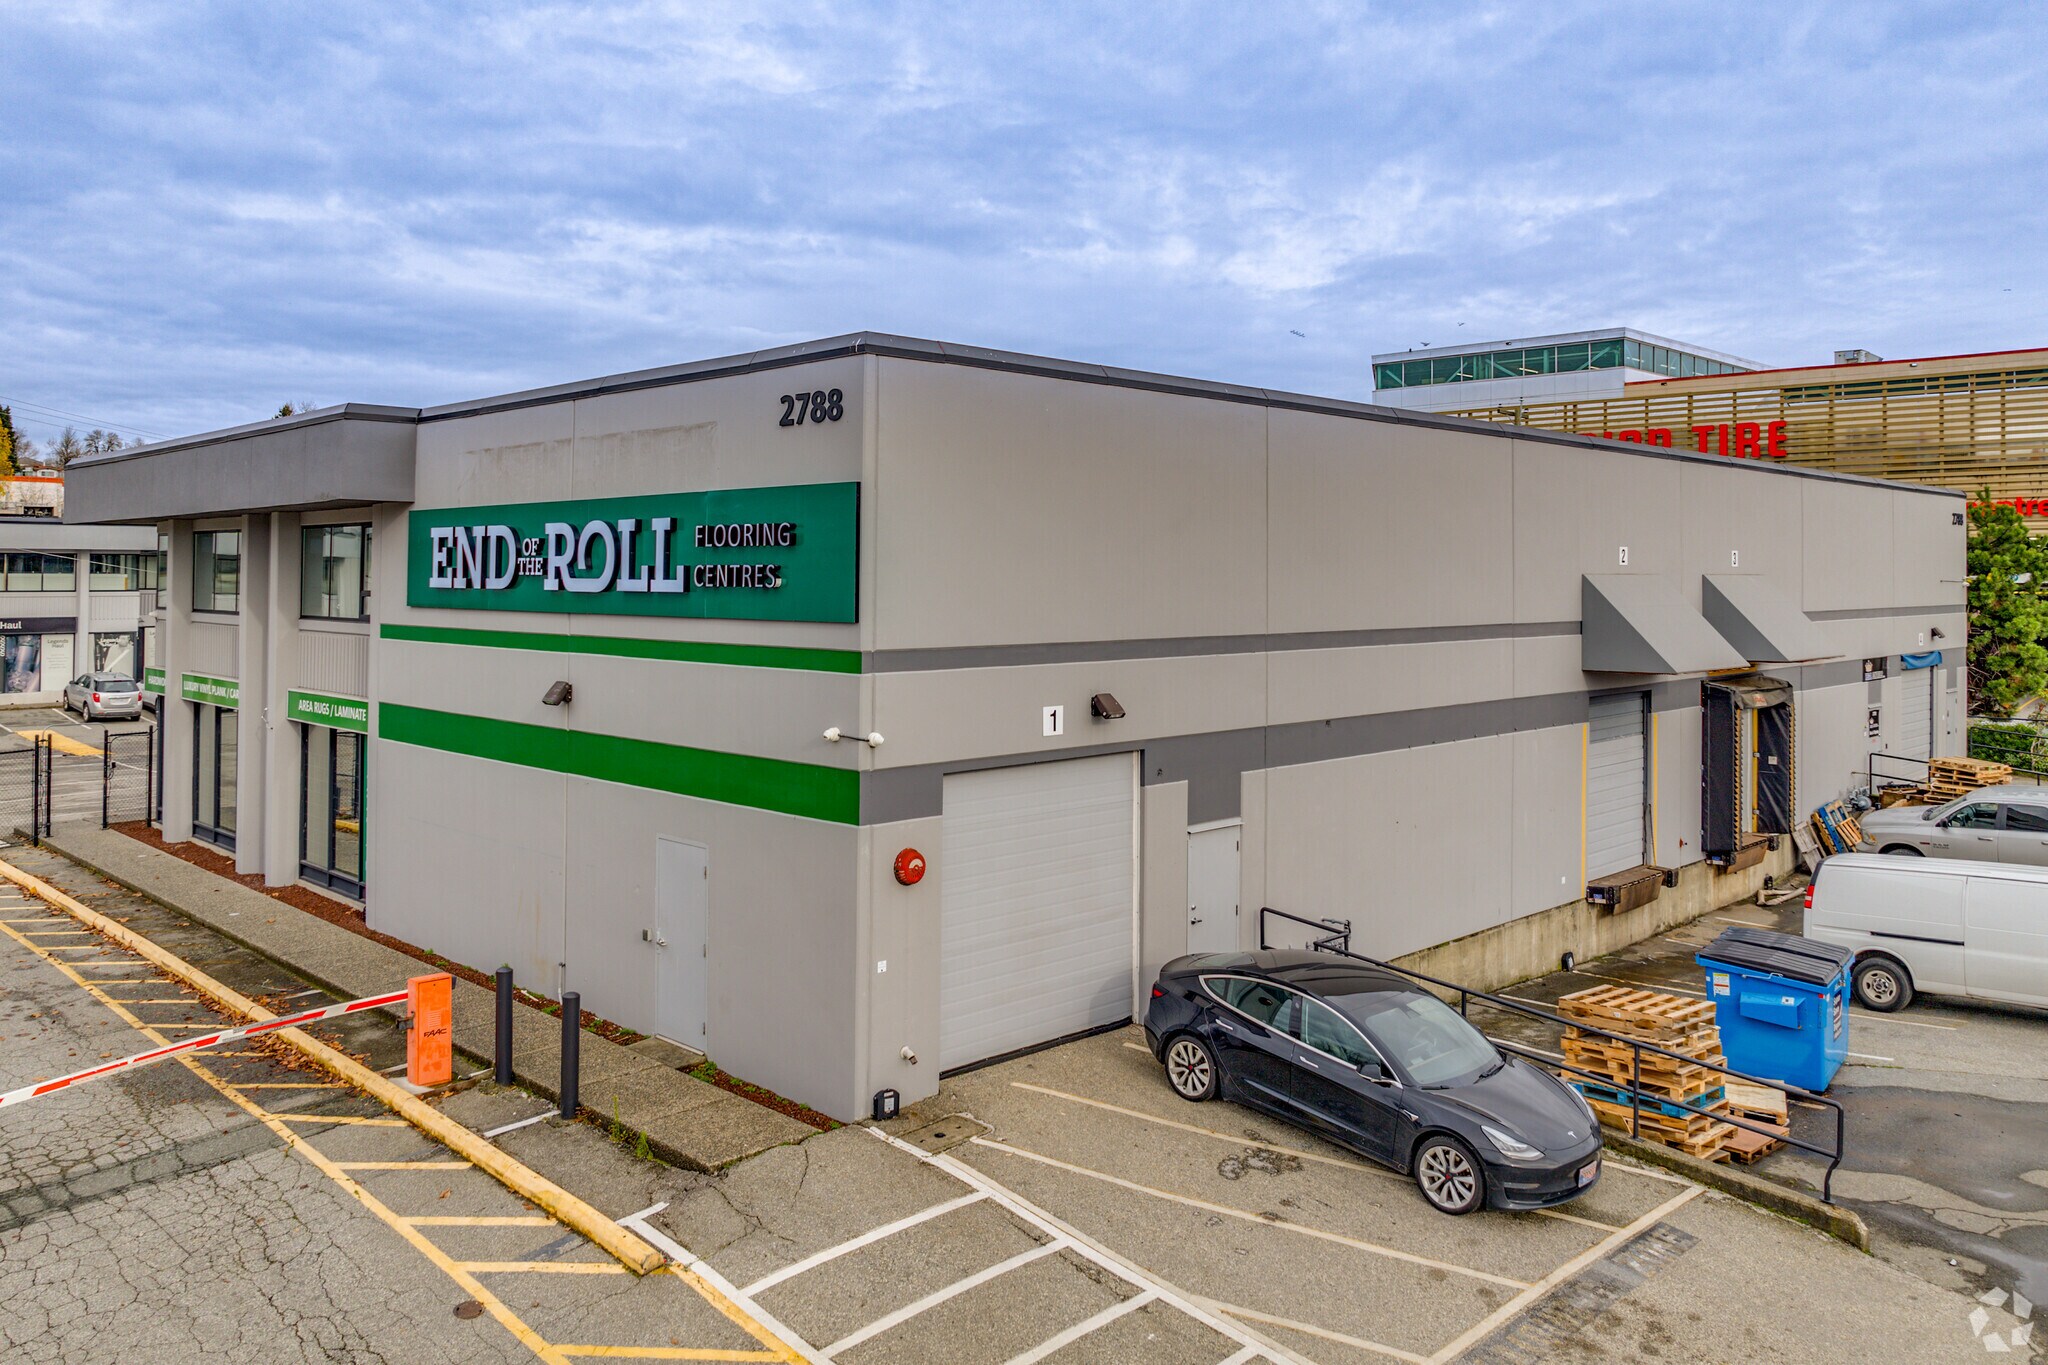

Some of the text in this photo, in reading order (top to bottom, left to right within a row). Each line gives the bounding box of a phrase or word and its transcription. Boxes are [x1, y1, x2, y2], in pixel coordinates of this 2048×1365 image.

[779, 388, 844, 427] 2788
[1692, 420, 1787, 458] TIRE
[695, 522, 791, 548] FLOORING
[429, 517, 685, 593] END OF THE ROLL
[693, 564, 778, 588] CENTRES
[183, 680, 199, 692] LUXURY
[199, 683, 211, 695] VINYL
[211, 686, 226, 698] PLANK
[298, 699, 313, 713] AREA
[314, 702, 330, 715] RUGS
[334, 704, 367, 722] LAMINATE
[1050, 709, 1057, 732] 1
[423, 1028, 448, 1038] FAAC
